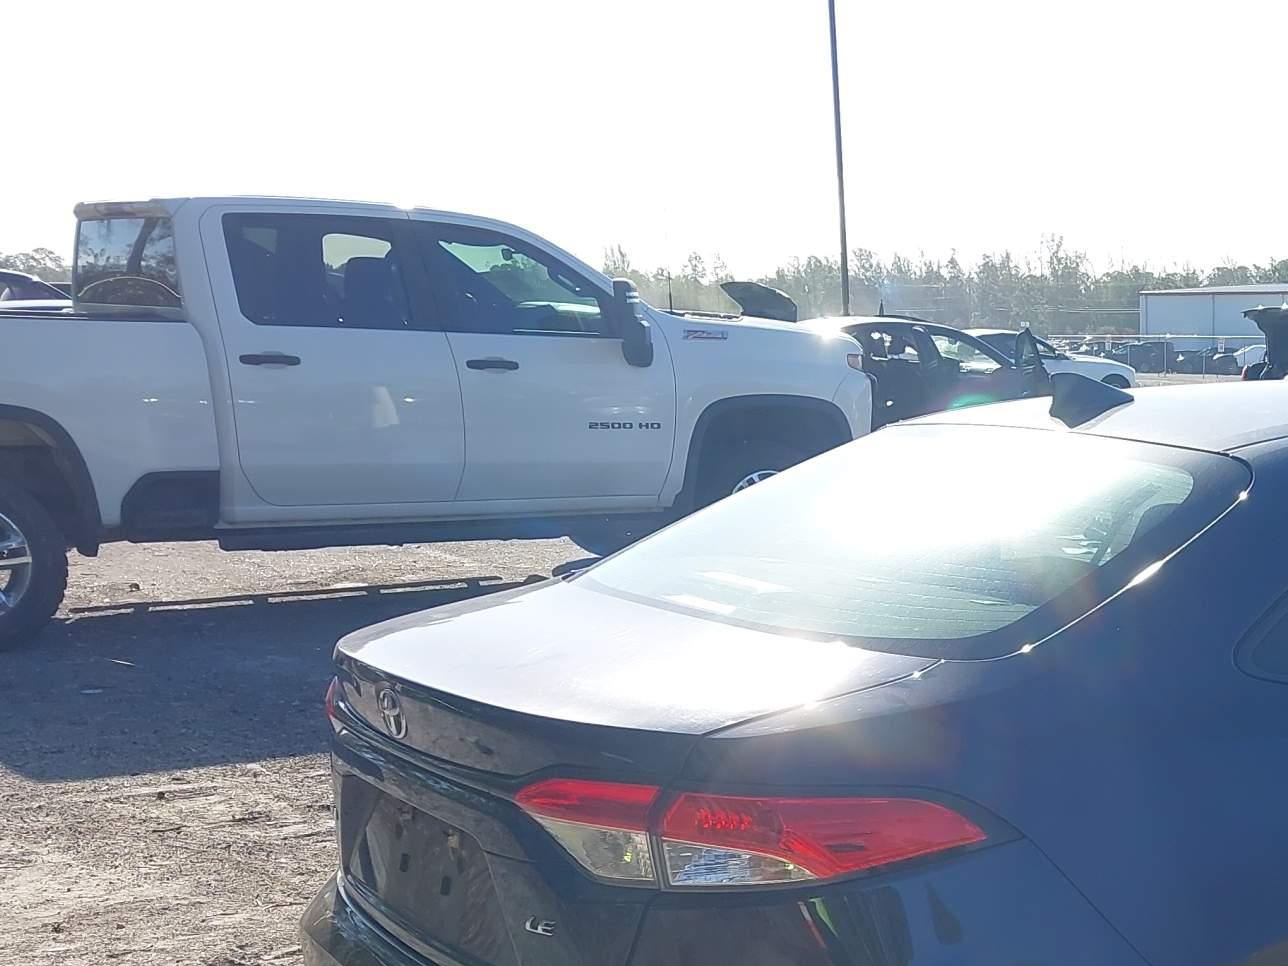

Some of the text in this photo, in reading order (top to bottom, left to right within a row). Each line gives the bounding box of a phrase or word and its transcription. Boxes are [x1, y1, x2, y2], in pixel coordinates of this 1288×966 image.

[588, 422, 661, 430] 2500 HD
[525, 916, 556, 936] LE
